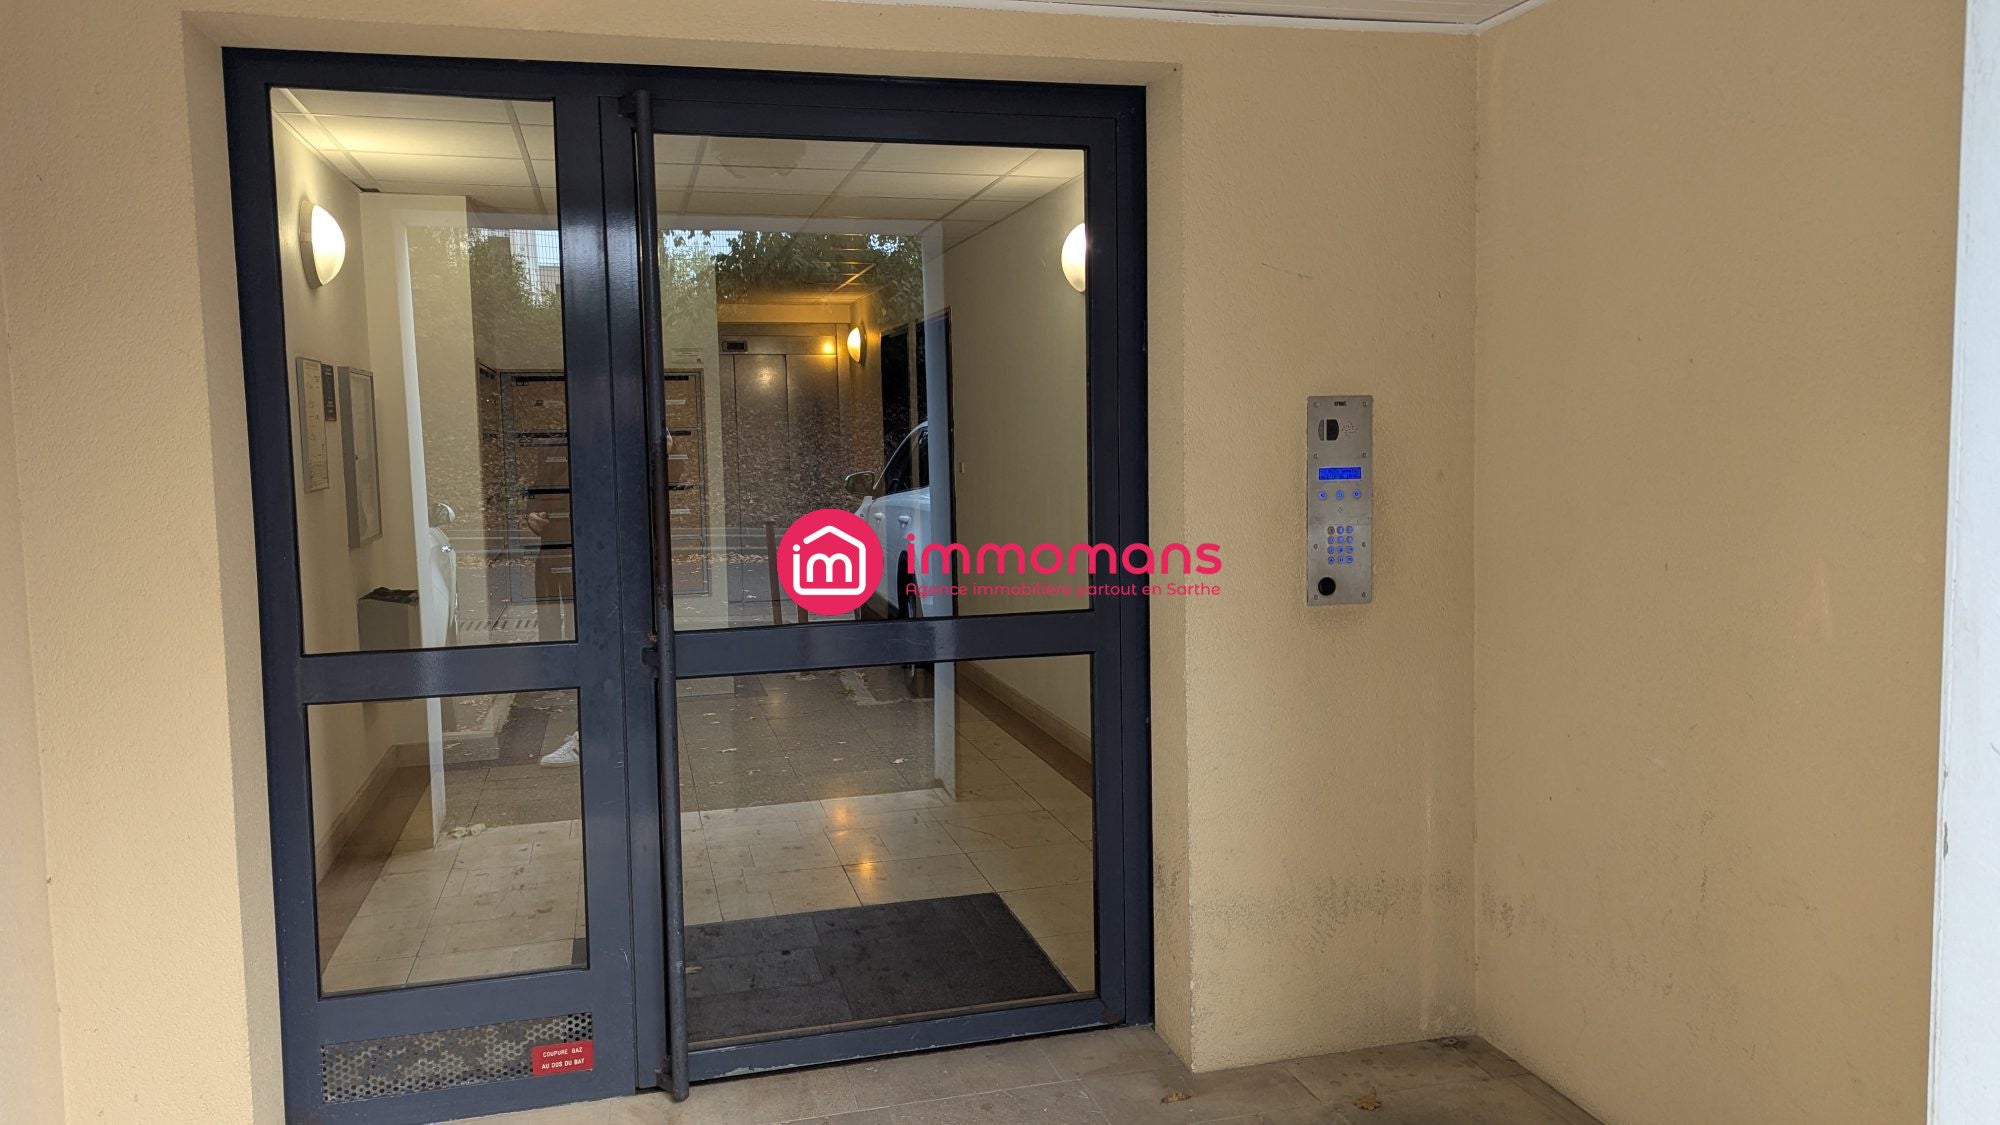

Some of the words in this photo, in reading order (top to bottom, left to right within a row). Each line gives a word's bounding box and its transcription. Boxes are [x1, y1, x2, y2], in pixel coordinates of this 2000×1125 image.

[542, 1048, 568, 1058] COUPURE
[571, 1046, 583, 1054] GAZ
[551, 1061, 563, 1069] DOS
[573, 1058, 585, 1066] BAT
